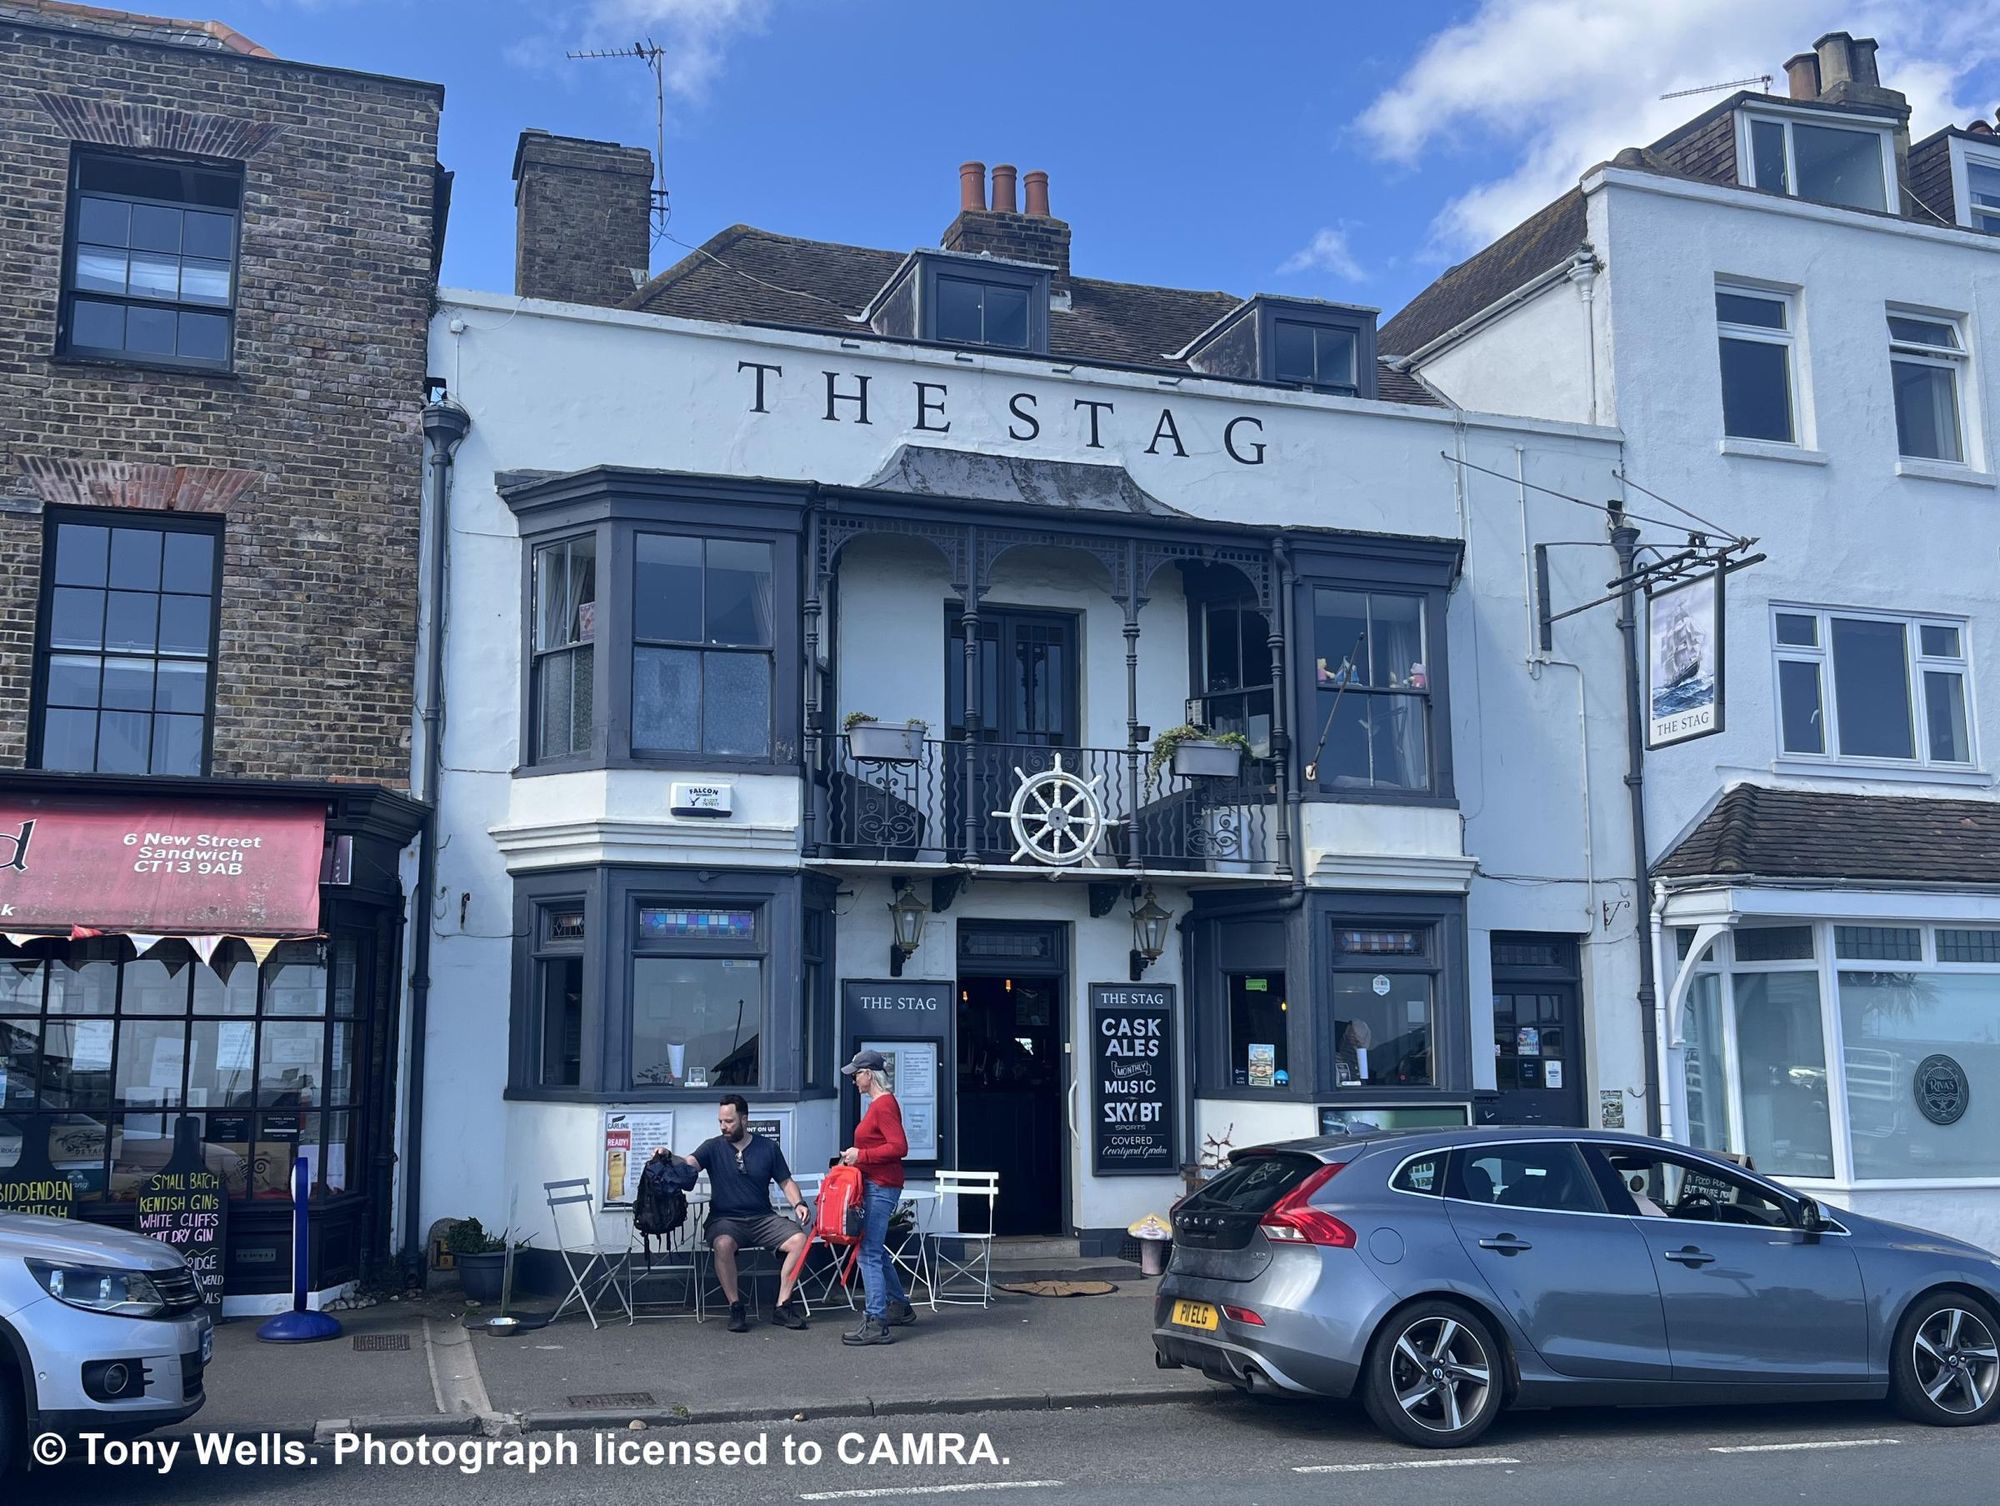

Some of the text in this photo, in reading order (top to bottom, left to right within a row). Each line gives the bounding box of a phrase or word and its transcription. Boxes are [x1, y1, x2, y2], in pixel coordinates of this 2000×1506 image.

[737, 360, 1267, 466] THE STAG
[1657, 711, 1710, 736] THE STAG
[688, 787, 719, 796] FALCON
[123, 832, 262, 848] 6 New Street
[138, 846, 244, 862] Sandwich
[134, 860, 243, 876] CT13 9AB
[860, 996, 937, 1011] THE STAG
[1100, 992, 1164, 1005] THE STAG
[1101, 1018, 1162, 1037] CASK
[1105, 1038, 1160, 1057] ALES
[1116, 1062, 1147, 1077] MONTHLY
[1104, 1080, 1157, 1094] MUSIC
[1103, 1102, 1163, 1122] SKY BT
[607, 1138, 629, 1147] READY!
[1111, 1136, 1153, 1145] COVERED
[150, 1172, 219, 1191] SMALL BATCH
[140, 1196, 185, 1213] KENTISH
[140, 1212, 219, 1229] WHITE CLIFFS
[171, 1228, 191, 1243] DRY
[194, 1228, 214, 1242] GIN
